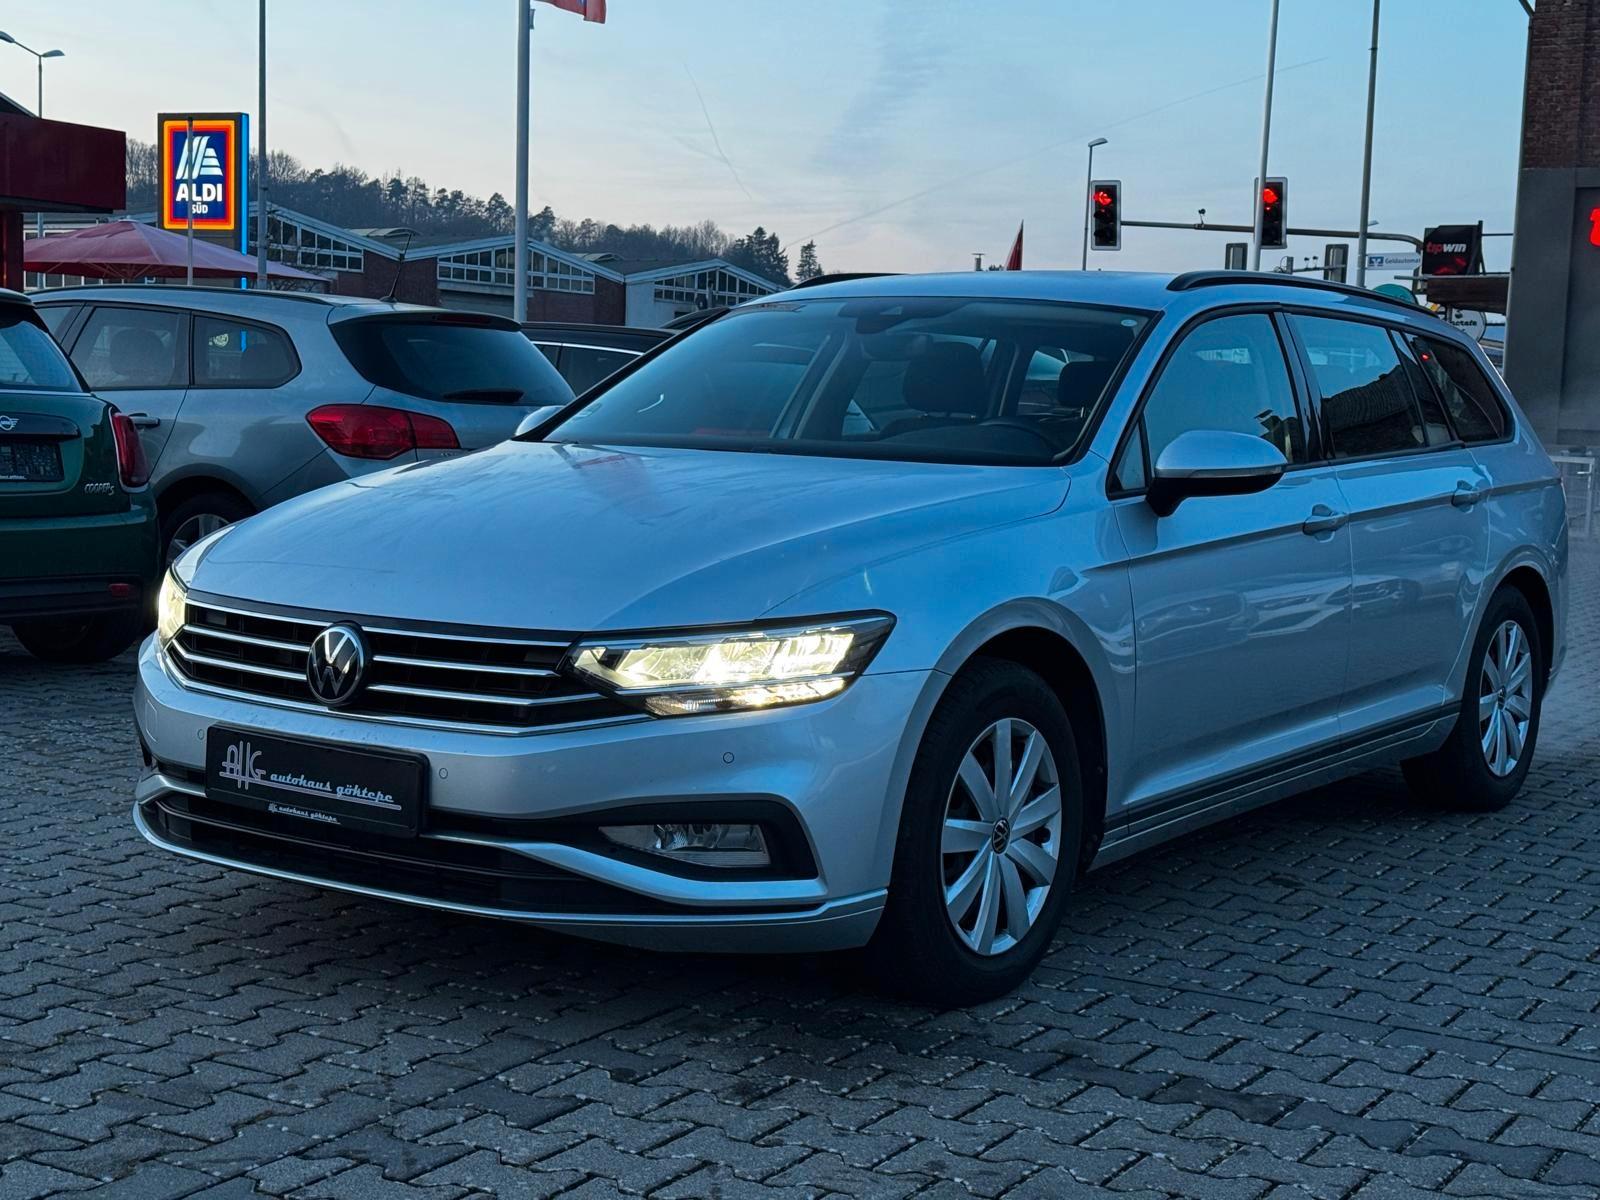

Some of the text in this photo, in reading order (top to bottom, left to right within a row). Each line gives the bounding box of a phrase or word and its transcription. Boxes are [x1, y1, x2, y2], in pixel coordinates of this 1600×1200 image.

[176, 183, 223, 202] ALDI
[191, 202, 209, 214] SÜD
[1426, 241, 1467, 255] tipwin
[270, 772, 332, 792] autohaus
[336, 784, 395, 803] göktepe
